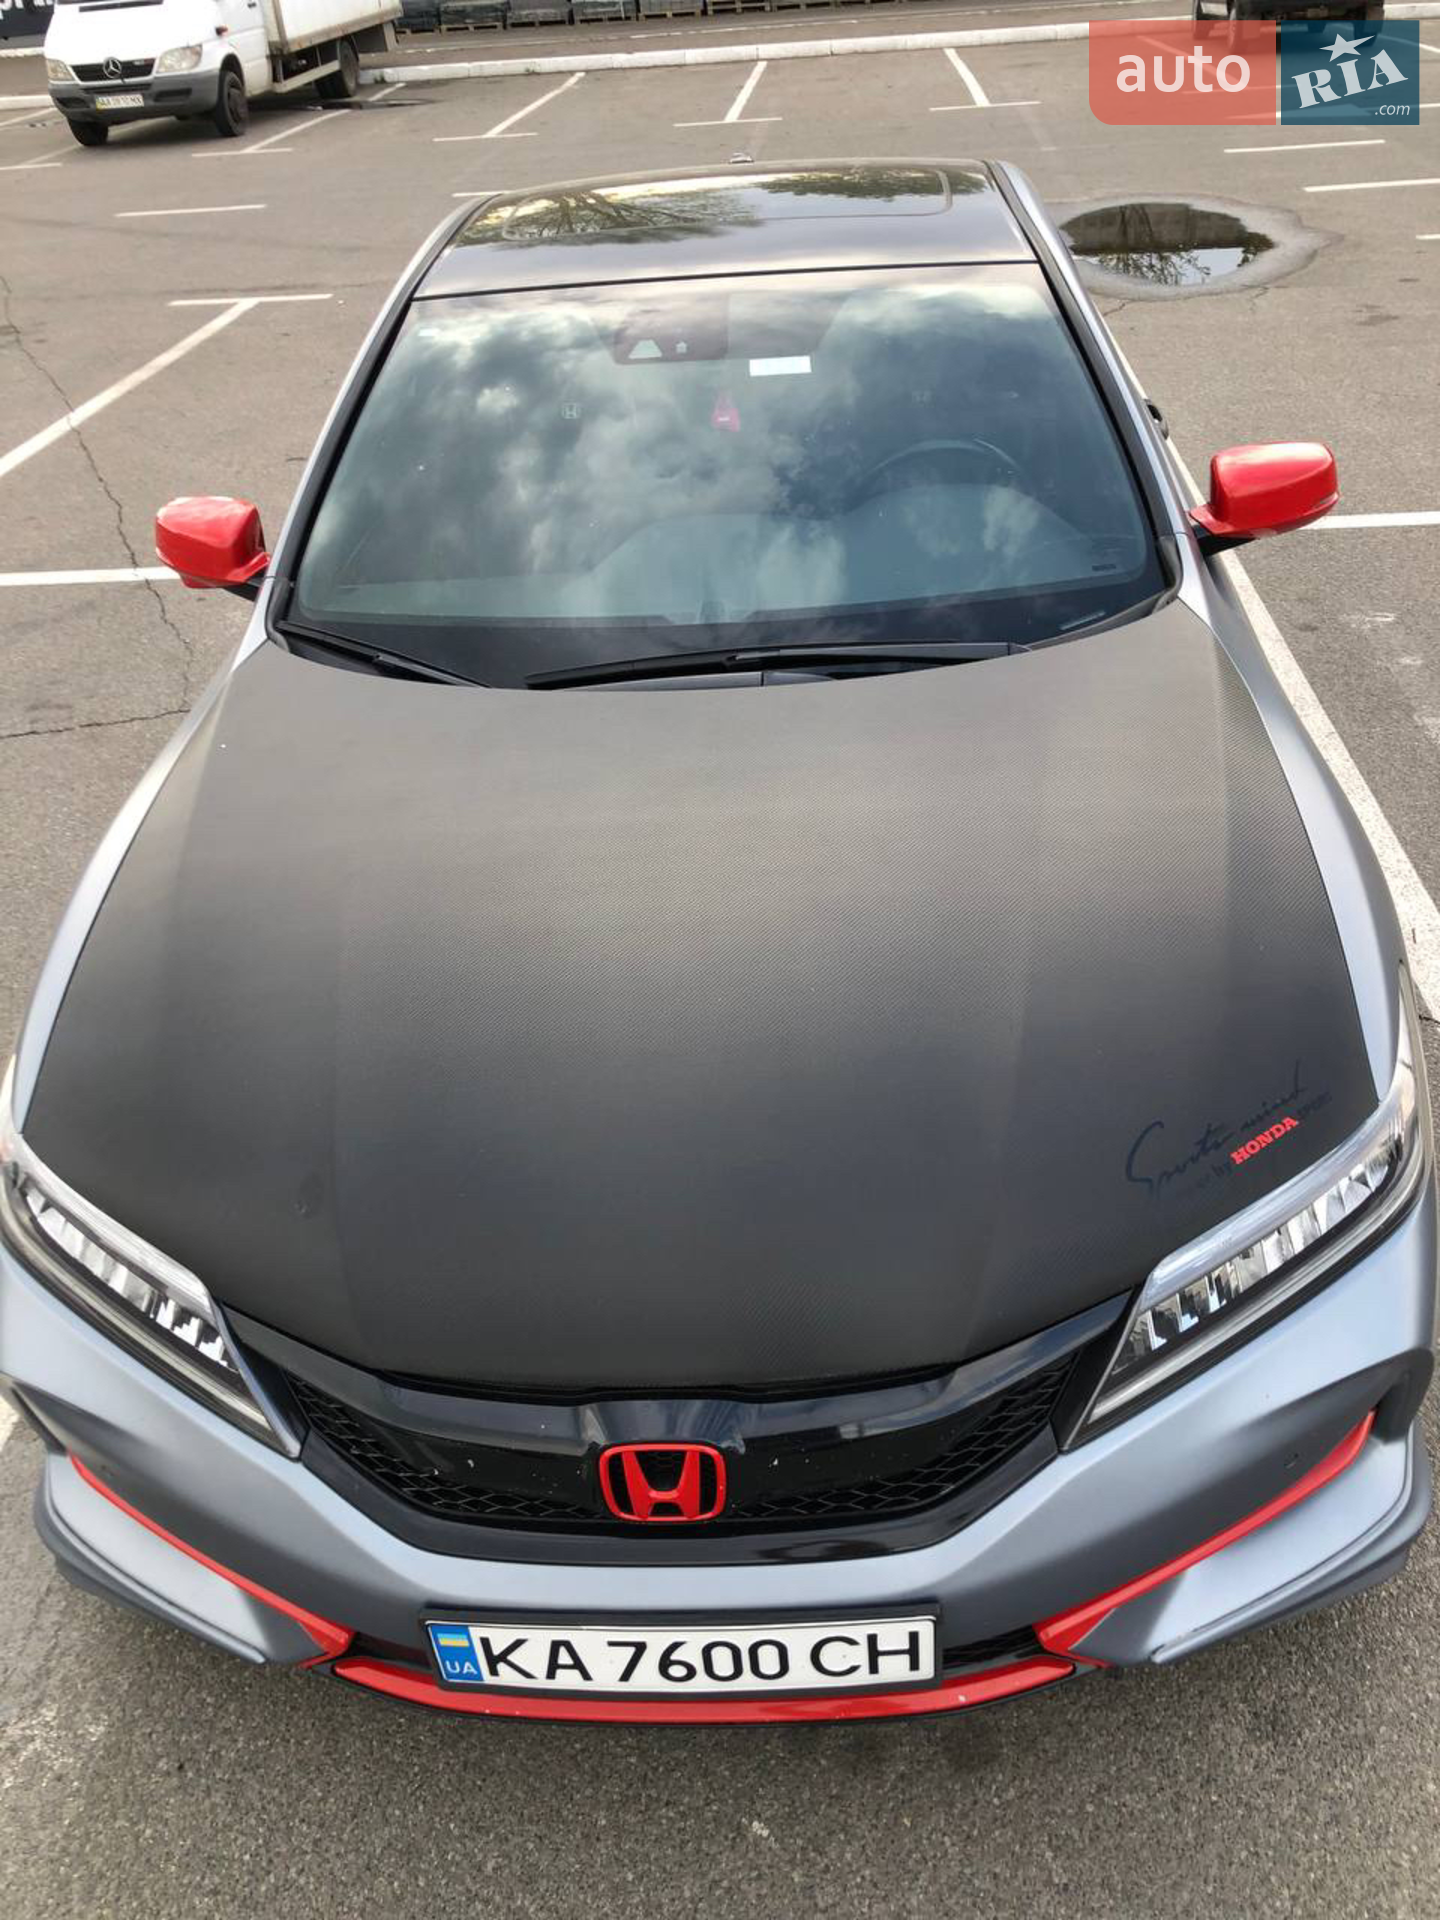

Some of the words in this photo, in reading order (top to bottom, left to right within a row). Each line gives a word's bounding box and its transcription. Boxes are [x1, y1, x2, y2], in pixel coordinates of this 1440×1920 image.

[1230, 1115, 1299, 1165] HONDA
[445, 1660, 478, 1675] UA
[480, 1636, 593, 1681] KA
[606, 1638, 789, 1682] 7600
[810, 1631, 920, 1677] CH
